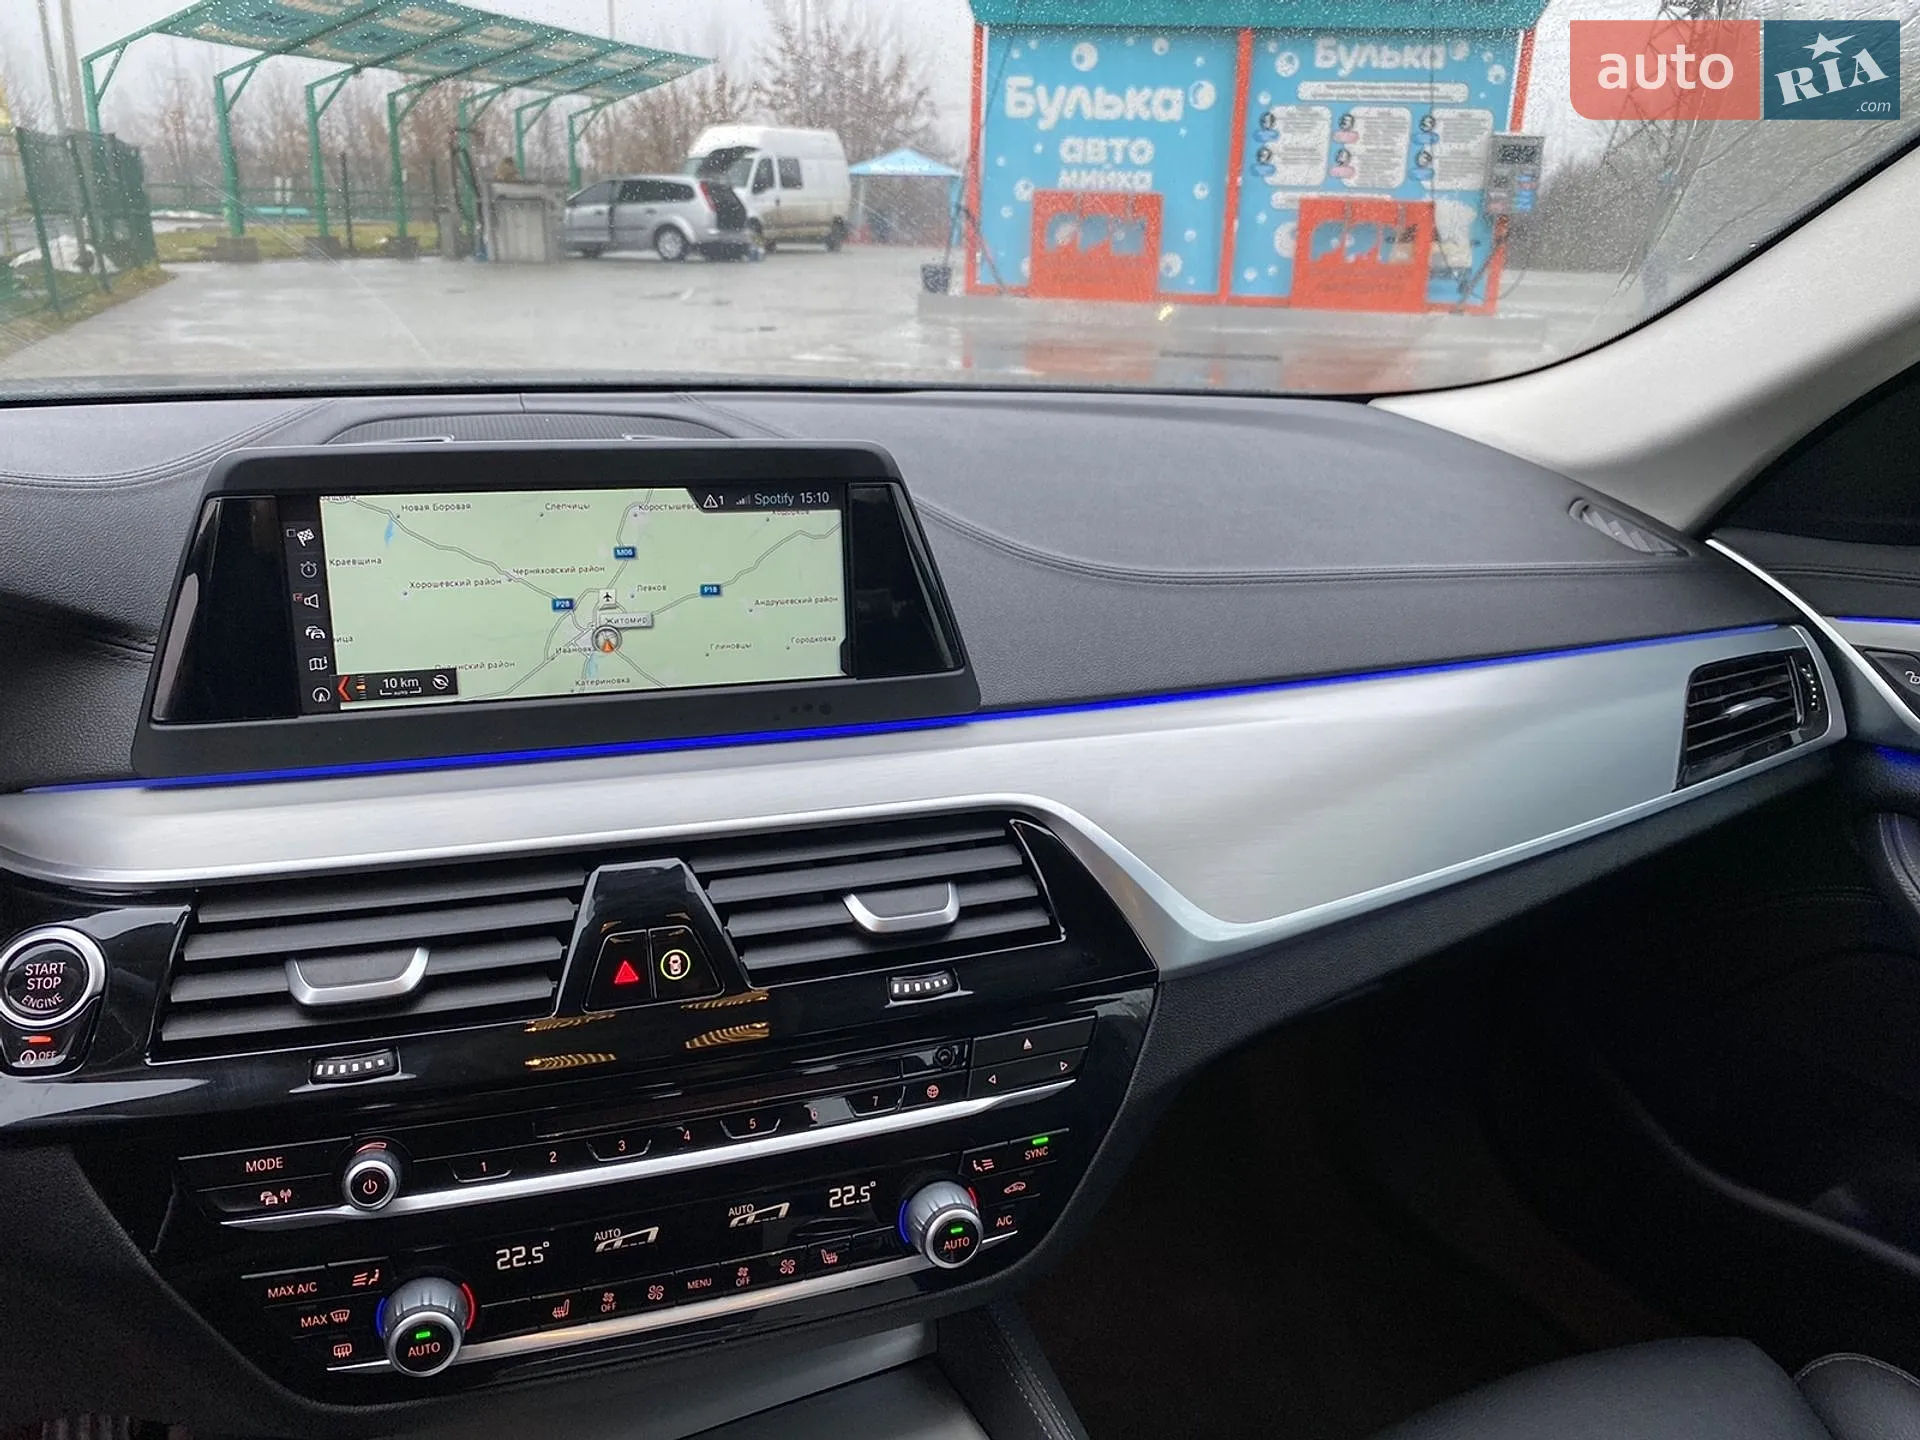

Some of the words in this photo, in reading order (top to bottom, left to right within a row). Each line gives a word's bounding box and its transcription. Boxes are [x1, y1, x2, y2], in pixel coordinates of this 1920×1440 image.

[1314, 36, 1447, 76] Булька
[1005, 76, 1184, 131] Булька
[1059, 137, 1154, 165] авто
[717, 495, 724, 505] 1
[754, 493, 794, 507] Spotify
[800, 491, 830, 504] 15:10
[401, 504, 430, 512] Новая
[432, 502, 472, 512] Боровая
[578, 565, 605, 574] район
[474, 578, 502, 587] район
[815, 596, 838, 604] район
[605, 616, 649, 625] Житомир
[487, 660, 515, 670] район
[383, 678, 398, 689] 10
[400, 677, 419, 688] km
[24, 961, 66, 977] START
[26, 976, 62, 991] STOP
[21, 993, 65, 1010] ENGINE
[38, 1050, 57, 1061] OFF
[749, 1118, 757, 1130] 5
[682, 1130, 691, 1142] 4
[618, 1140, 626, 1151] 3
[549, 1151, 557, 1163] 2
[1024, 1146, 1050, 1161] SYNC
[245, 1156, 284, 1173] MODE
[480, 1161, 488, 1173] 1
[727, 1203, 755, 1217] AUTO
[995, 1214, 1014, 1228] A/C
[593, 1227, 622, 1241] AUTO
[943, 1236, 971, 1251] AUTO
[687, 1277, 713, 1290] MENU
[735, 1276, 751, 1287] OFF
[267, 1286, 295, 1300] MAX
[297, 1281, 318, 1297] A/C
[600, 1301, 617, 1314] OFF
[300, 1314, 328, 1329] MAX
[407, 1341, 441, 1358] AUTO
